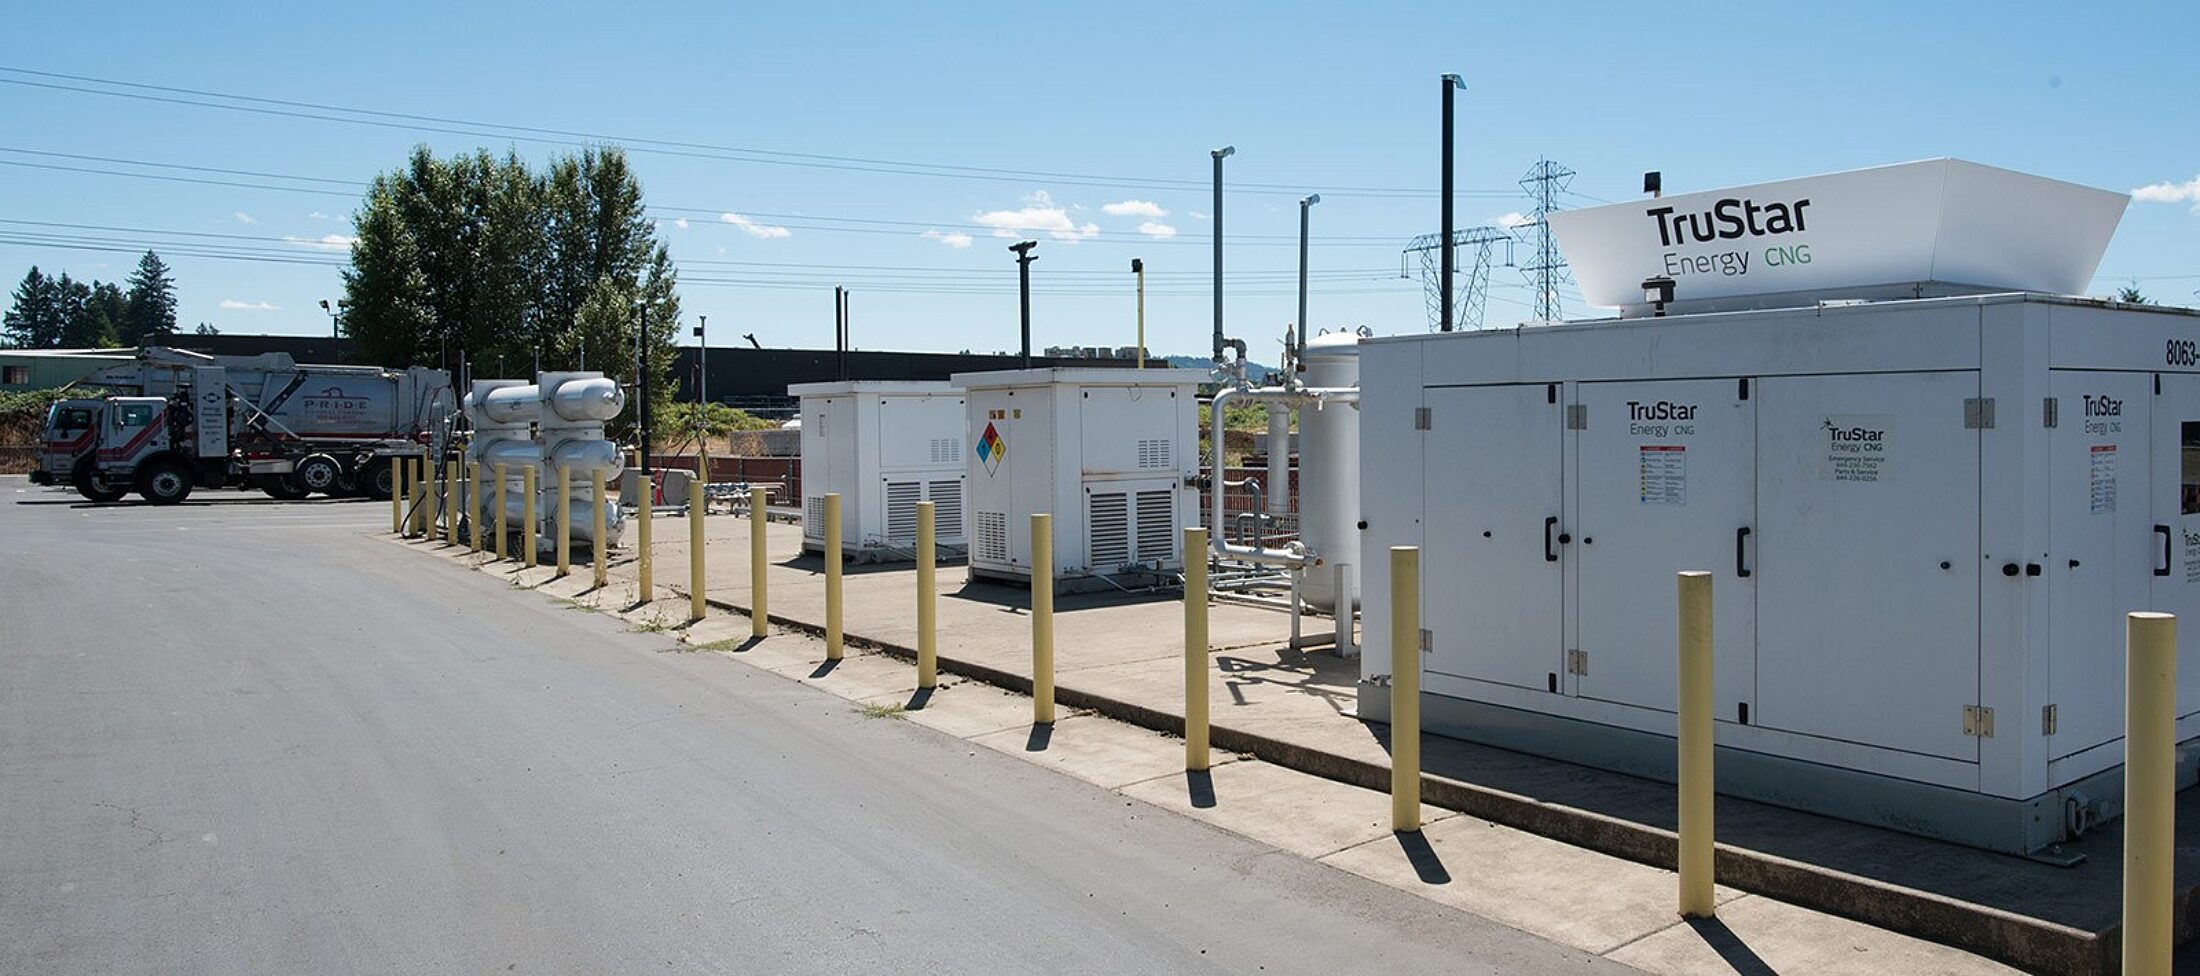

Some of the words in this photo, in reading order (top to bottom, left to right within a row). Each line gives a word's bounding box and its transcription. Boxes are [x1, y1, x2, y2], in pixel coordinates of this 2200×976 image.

[1647, 198, 1810, 247] TruStar
[1663, 251, 1750, 276] Energy
[1764, 244, 1812, 267] CNG
[1626, 401, 1698, 420] TruStar
[2083, 394, 2123, 417] TruStar
[1630, 423, 1669, 438] Energy
[1674, 424, 1695, 436] CNG
[1828, 427, 1884, 441] TruStar
[2085, 419, 2108, 435] Energy
[1831, 442, 1861, 453] Energy
[1863, 442, 1883, 452] CNG
[1828, 455, 1862, 463] Emergency
